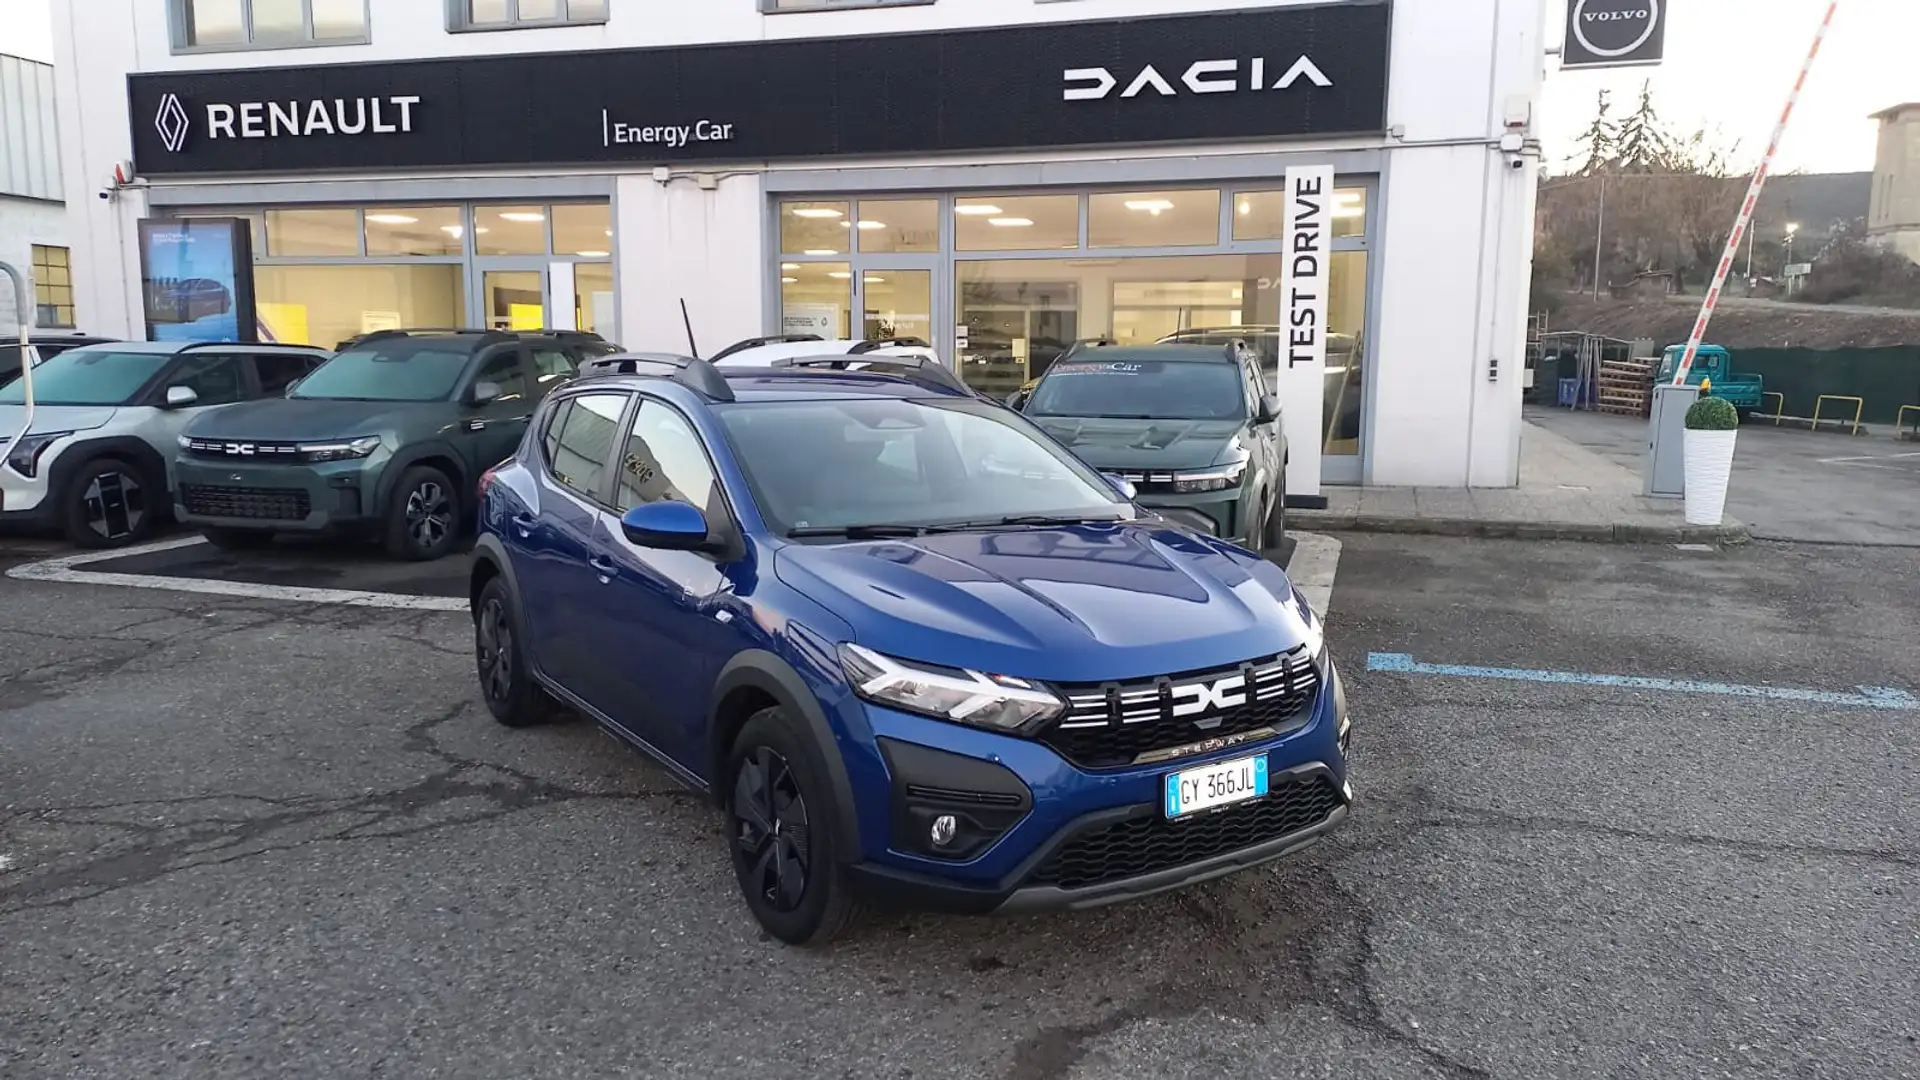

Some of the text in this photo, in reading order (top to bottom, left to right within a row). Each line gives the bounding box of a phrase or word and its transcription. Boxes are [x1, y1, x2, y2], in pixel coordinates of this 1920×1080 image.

[1583, 9, 1648, 22] VOLVO
[1063, 55, 1332, 101] DACIA
[207, 95, 420, 139] RENAULT
[613, 119, 733, 147] Energy Car
[1288, 176, 1322, 369] TEST DRIVE
[1180, 778, 1200, 804] GY
[1207, 767, 1254, 798] 366JL
